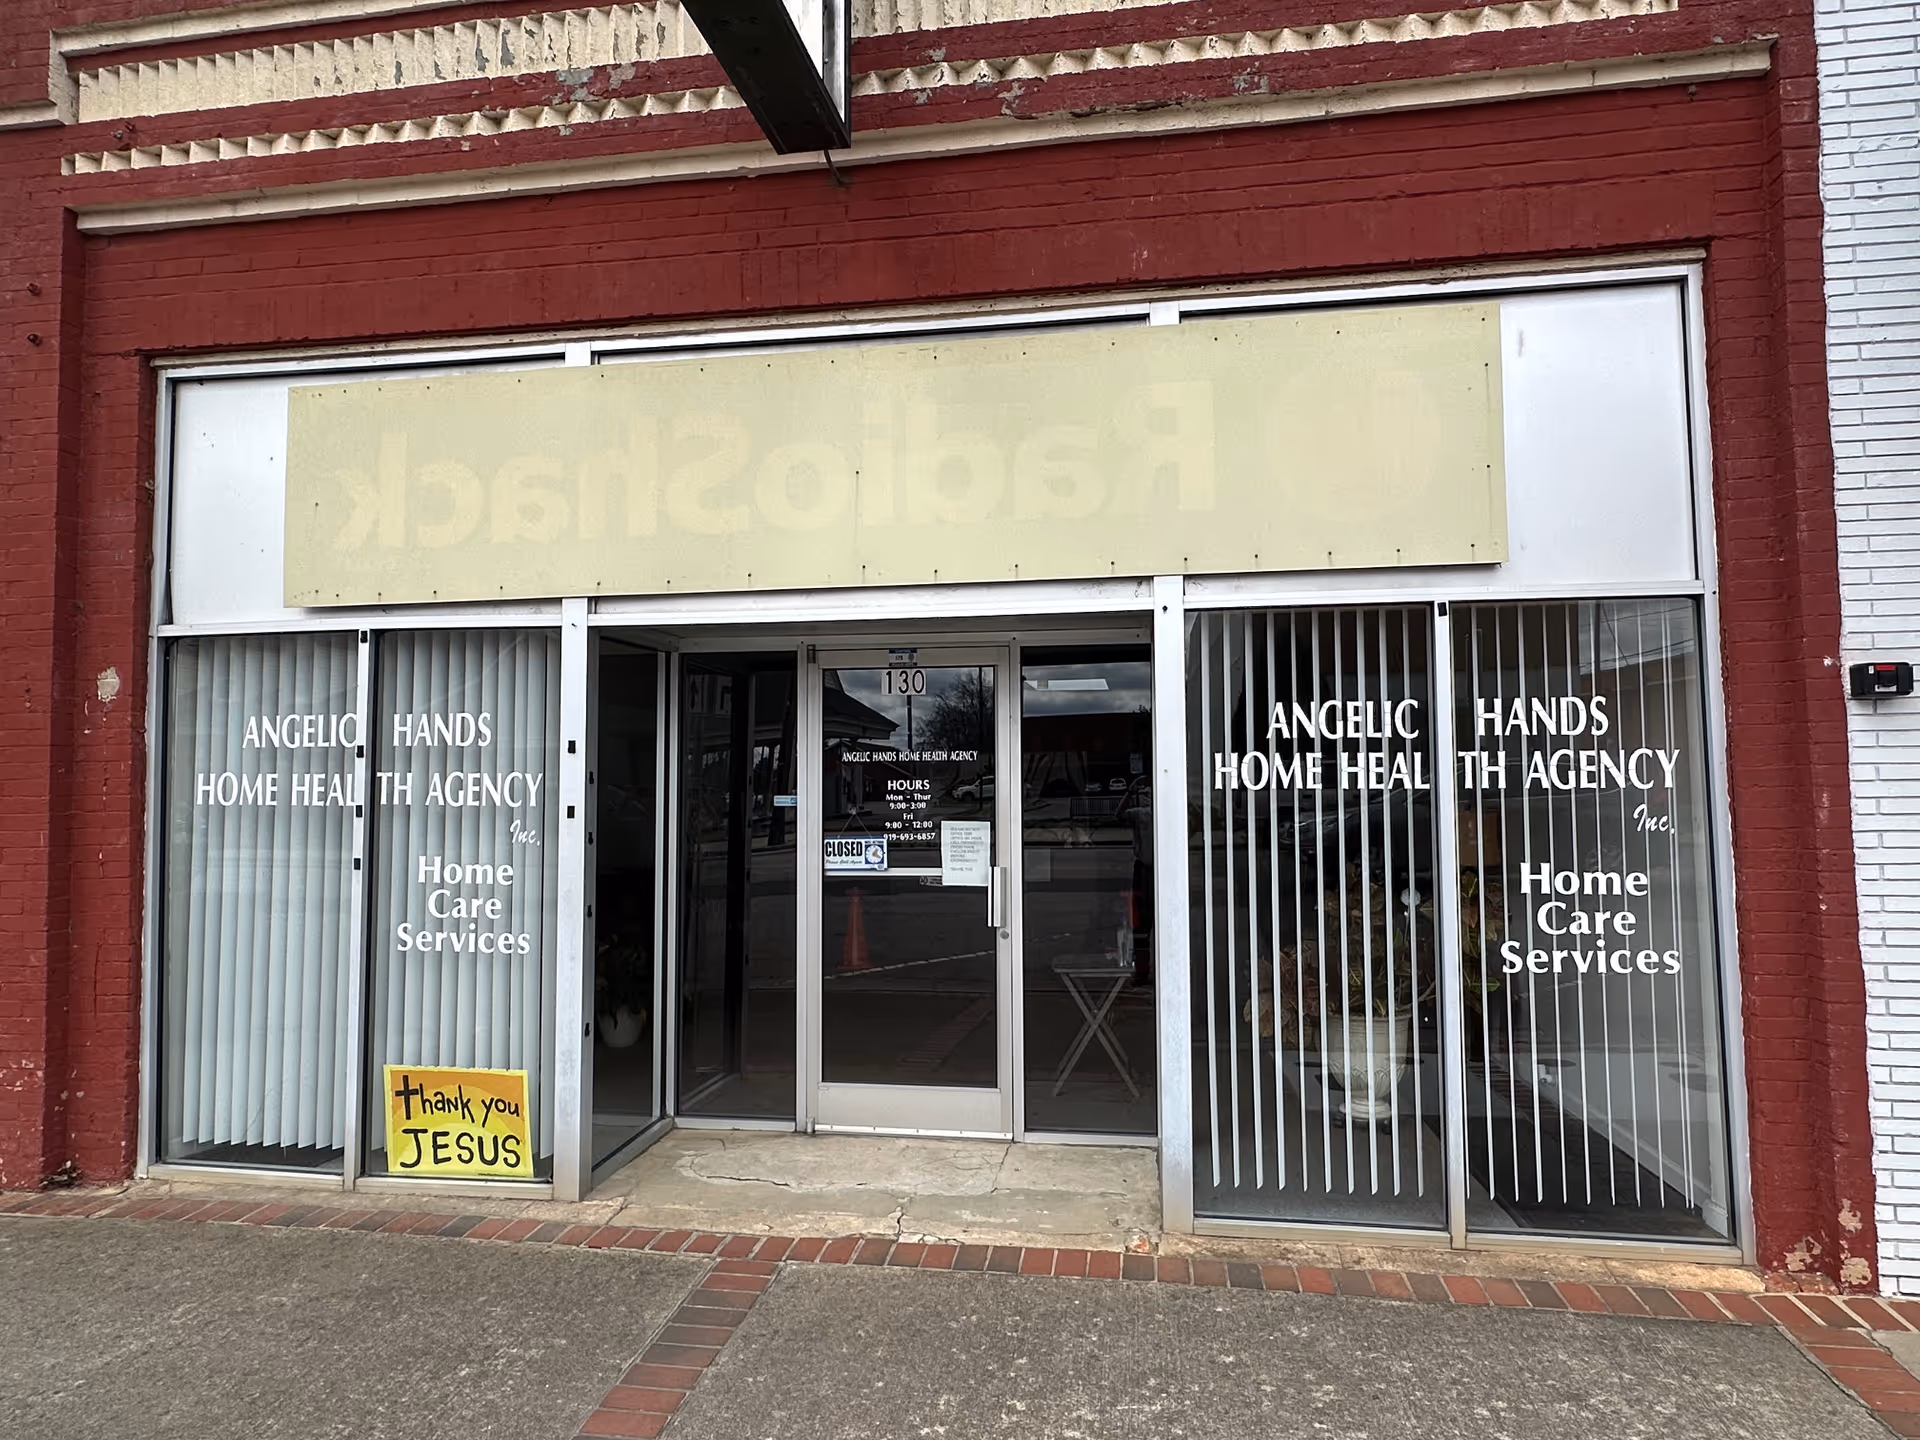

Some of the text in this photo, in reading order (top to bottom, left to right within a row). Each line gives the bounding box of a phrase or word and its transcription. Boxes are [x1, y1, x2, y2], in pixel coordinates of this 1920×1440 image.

[886, 669, 925, 694] 130
[242, 711, 492, 748] ANGELIC HANDS
[1266, 695, 1609, 739] ANGELIC HANDS
[841, 750, 978, 762] ANGELIC HANDS HOME HEALTH AGENCY
[1213, 750, 1323, 791] HOME
[1524, 748, 1680, 790] AGENCY
[196, 771, 279, 807] HOME
[425, 771, 543, 808] AGENCY
[885, 793, 904, 801] Mon
[887, 779, 930, 790] HOURS
[885, 821, 902, 829] 9:00
[912, 820, 933, 828] 12:00
[903, 812, 914, 820] Fri
[1633, 804, 1676, 835] Inc.
[509, 819, 541, 846] Inc.
[883, 833, 936, 841] 919-693-6857
[825, 840, 863, 857] CLOSED
[417, 855, 514, 886] Home
[1520, 862, 1649, 897] Home
[427, 889, 502, 920] Care
[1537, 901, 1638, 936] Care
[396, 922, 531, 955] Services
[1500, 940, 1681, 975] Services
[481, 1097, 520, 1128] you
[400, 1128, 521, 1168] JESUS
